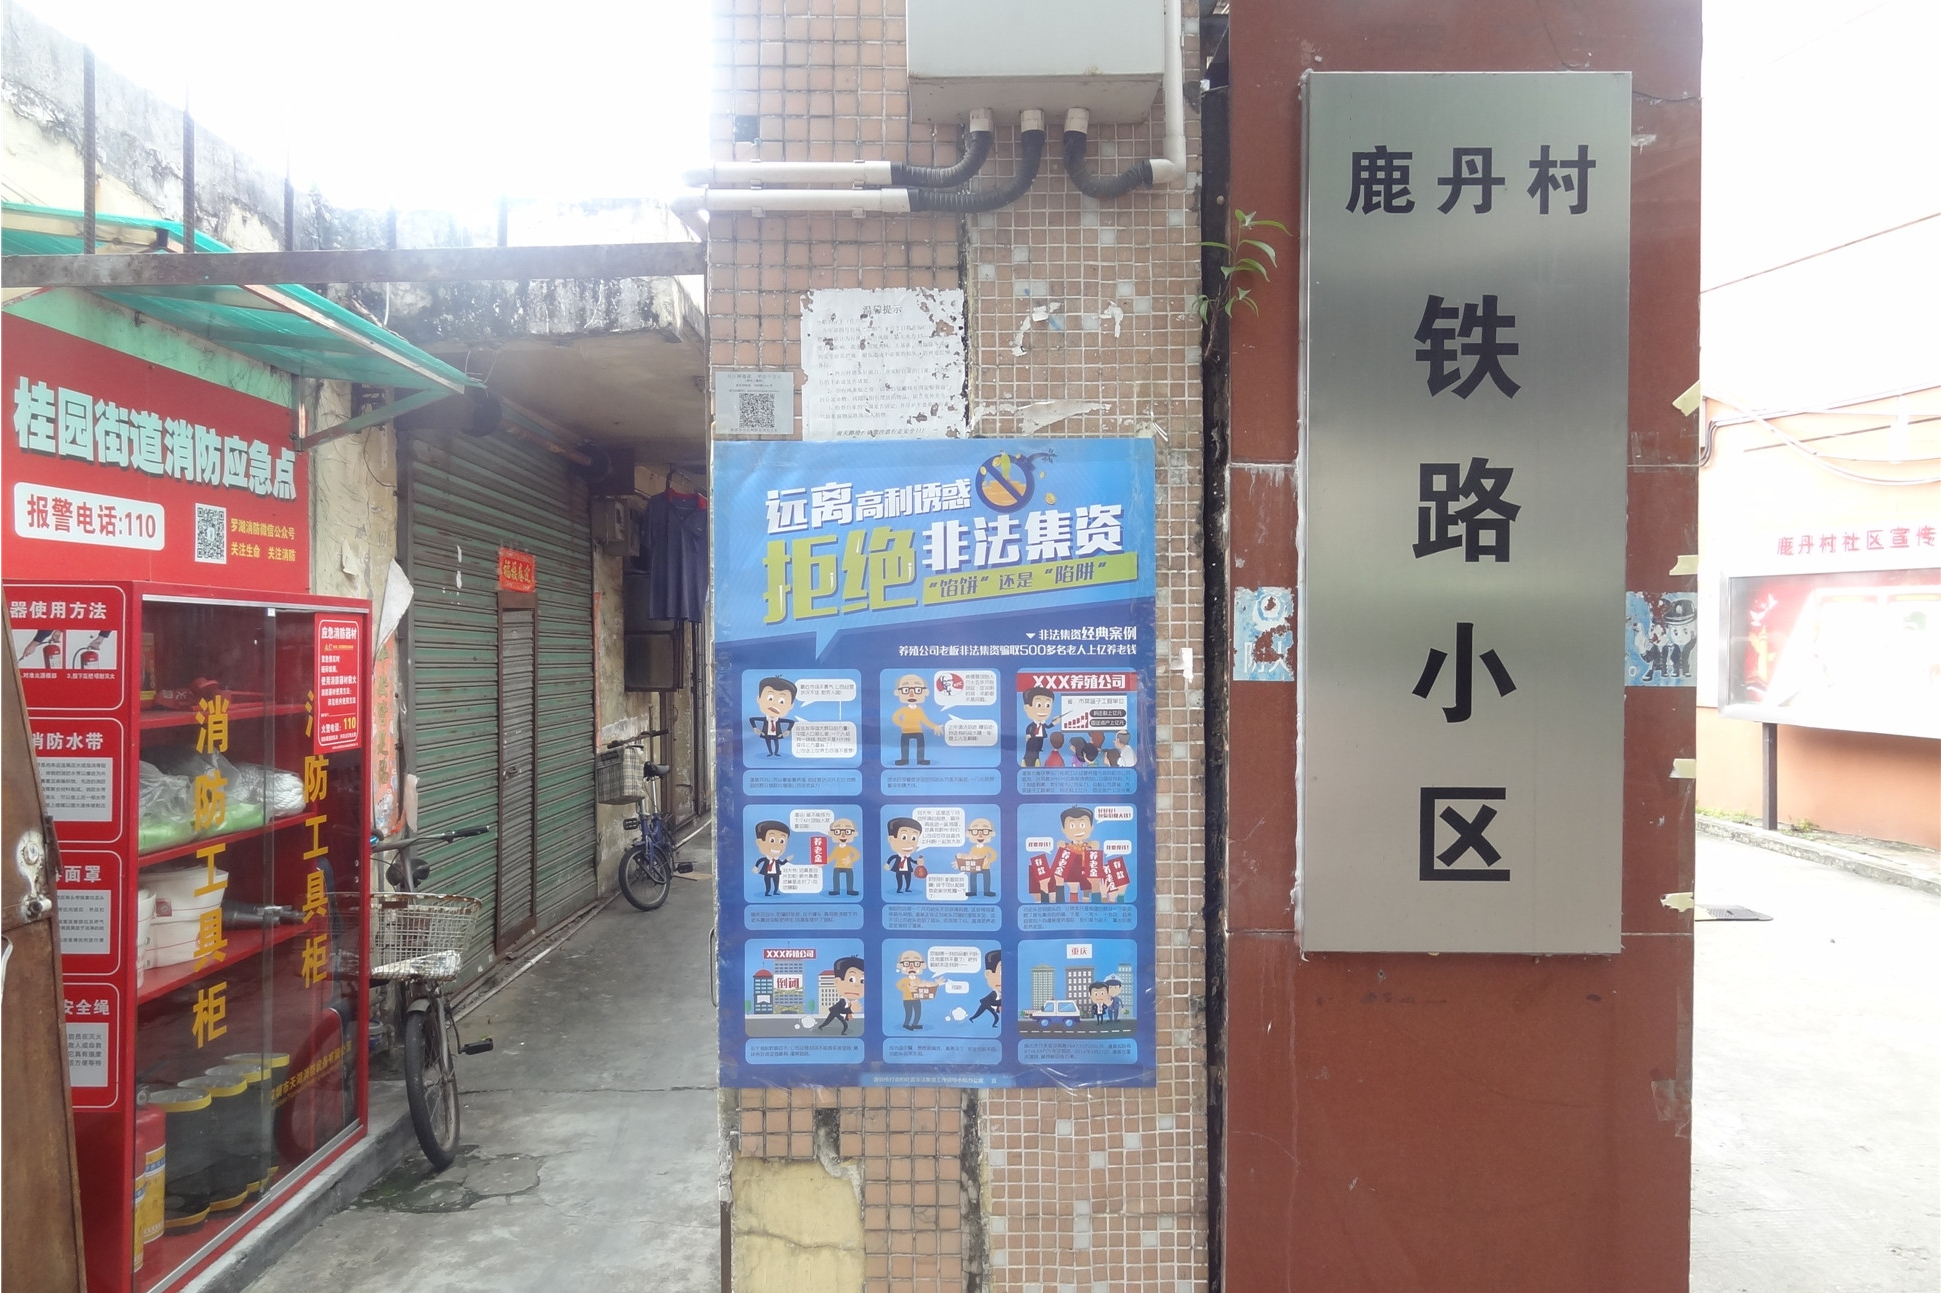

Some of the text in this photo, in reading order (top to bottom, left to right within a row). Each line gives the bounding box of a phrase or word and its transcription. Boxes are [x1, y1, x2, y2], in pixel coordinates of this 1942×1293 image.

[1346, 144, 1596, 215] 鹿丹村
[13, 376, 297, 500] 桂园街道消防应急点
[27, 493, 156, 539] 报警电话:110
[766, 480, 971, 533] 远离高利诱惑
[231, 518, 295, 540] 罗湖消防微信公众号
[922, 504, 1123, 571] 非法集资
[1777, 525, 1937, 556] 鹿丹村社区宣传
[231, 541, 296, 562] 关注生命 关注消防
[762, 525, 917, 624] 拒绝
[1412, 294, 1522, 881] 铁路小区
[321, 625, 357, 640] 应急消防器材
[1038, 626, 1136, 641] 非法集资经典案例
[899, 644, 1136, 656] 养殖公司老板非法集资骗取500多名老人上亿养老钱
[1032, 674, 1126, 689] XXX养殖公司
[344, 717, 356, 730] 110
[56, 865, 101, 883] 面罩
[193, 694, 230, 1048] 消防工具柜
[777, 977, 799, 989] 倒闭
